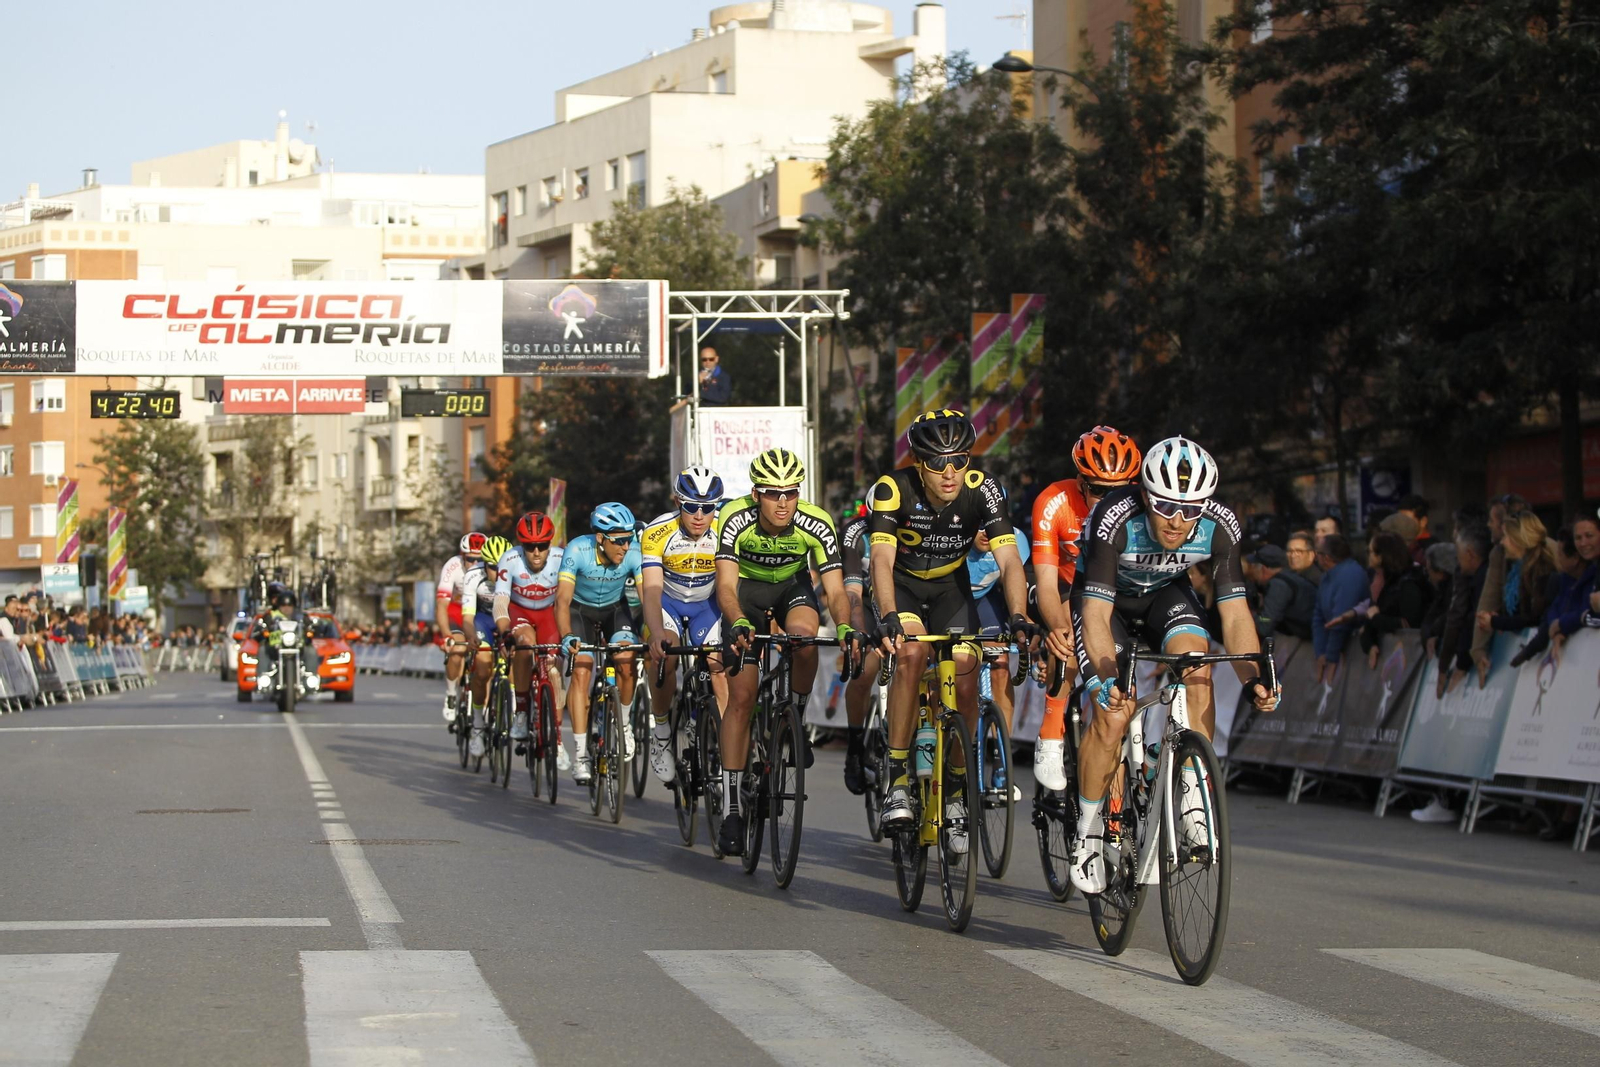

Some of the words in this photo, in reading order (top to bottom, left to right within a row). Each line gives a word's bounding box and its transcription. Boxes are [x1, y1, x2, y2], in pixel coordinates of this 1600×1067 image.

[76, 347, 152, 363] ROQUETAS
[183, 348, 219, 362] MAR
[354, 349, 431, 365] ROQUETAS
[462, 350, 498, 364] MAR
[230, 388, 290, 403] META
[298, 388, 363, 403] ARRIVEE
[980, 484, 998, 514] energie
[984, 478, 1004, 502] direct
[1043, 491, 1068, 520] GIANT
[721, 508, 758, 547] MURIAS
[1096, 496, 1137, 541] SYNERGIE
[793, 510, 837, 555] MURIAS
[923, 534, 963, 543] direct
[921, 537, 973, 550] energie
[1136, 553, 1191, 566] VITAL
